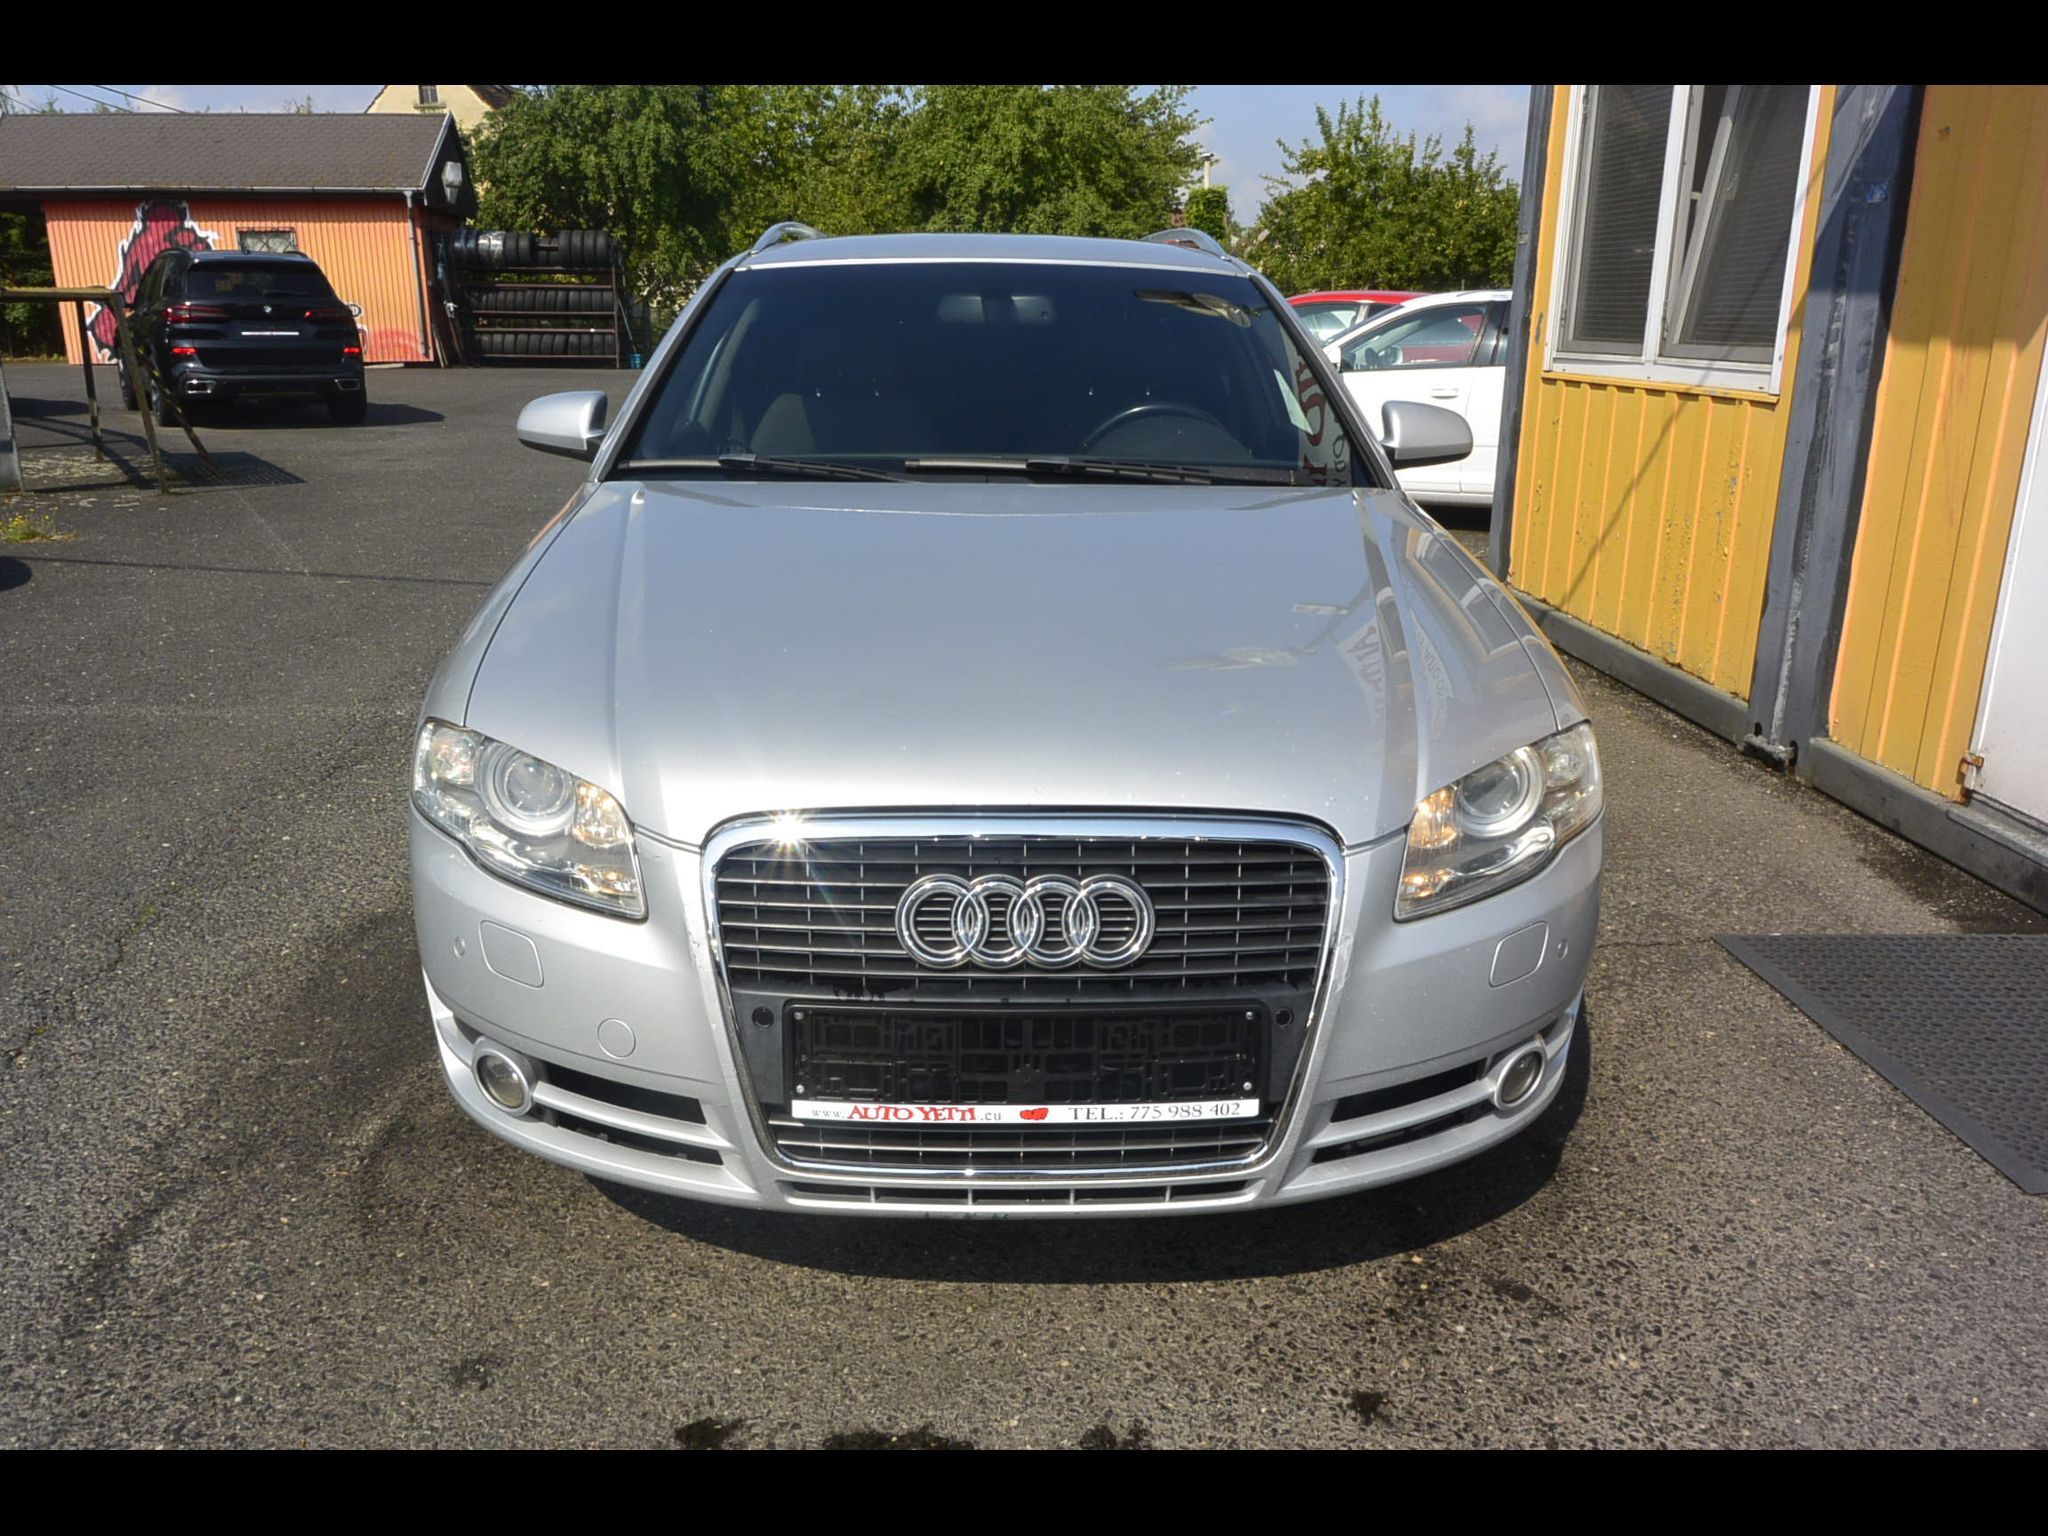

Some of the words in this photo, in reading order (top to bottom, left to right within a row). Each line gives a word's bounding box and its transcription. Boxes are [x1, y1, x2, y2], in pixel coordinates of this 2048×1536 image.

[847, 1105, 914, 1120] AUTO
[915, 1106, 977, 1121] YETTI
[1130, 1106, 1162, 1119] 775
[1168, 1105, 1202, 1118] 988
[1209, 1102, 1240, 1116] 402
